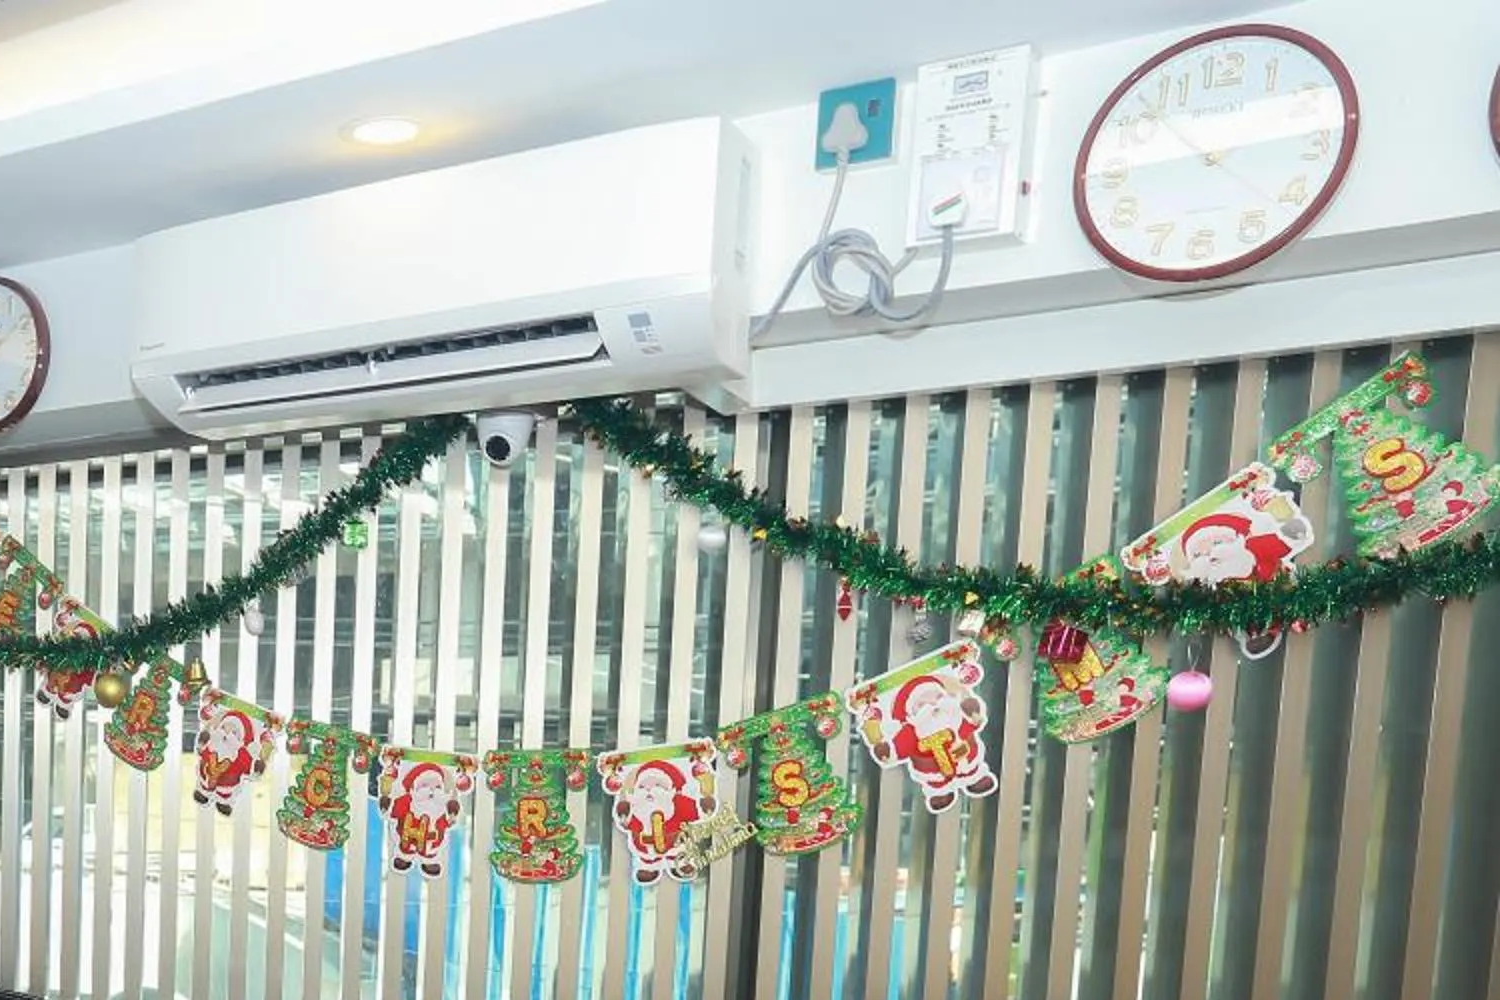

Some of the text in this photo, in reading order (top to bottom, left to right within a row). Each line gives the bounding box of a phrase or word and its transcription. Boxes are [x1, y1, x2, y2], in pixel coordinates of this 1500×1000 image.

[1202, 52, 1245, 90] 12
[1265, 58, 1279, 92] 1
[1158, 74, 1190, 109] 11
[1277, 175, 1308, 206] 4
[1110, 196, 1139, 229] 8
[1238, 210, 1266, 243] 5
[1146, 221, 1175, 257] 7
[1187, 229, 1215, 260] 6
